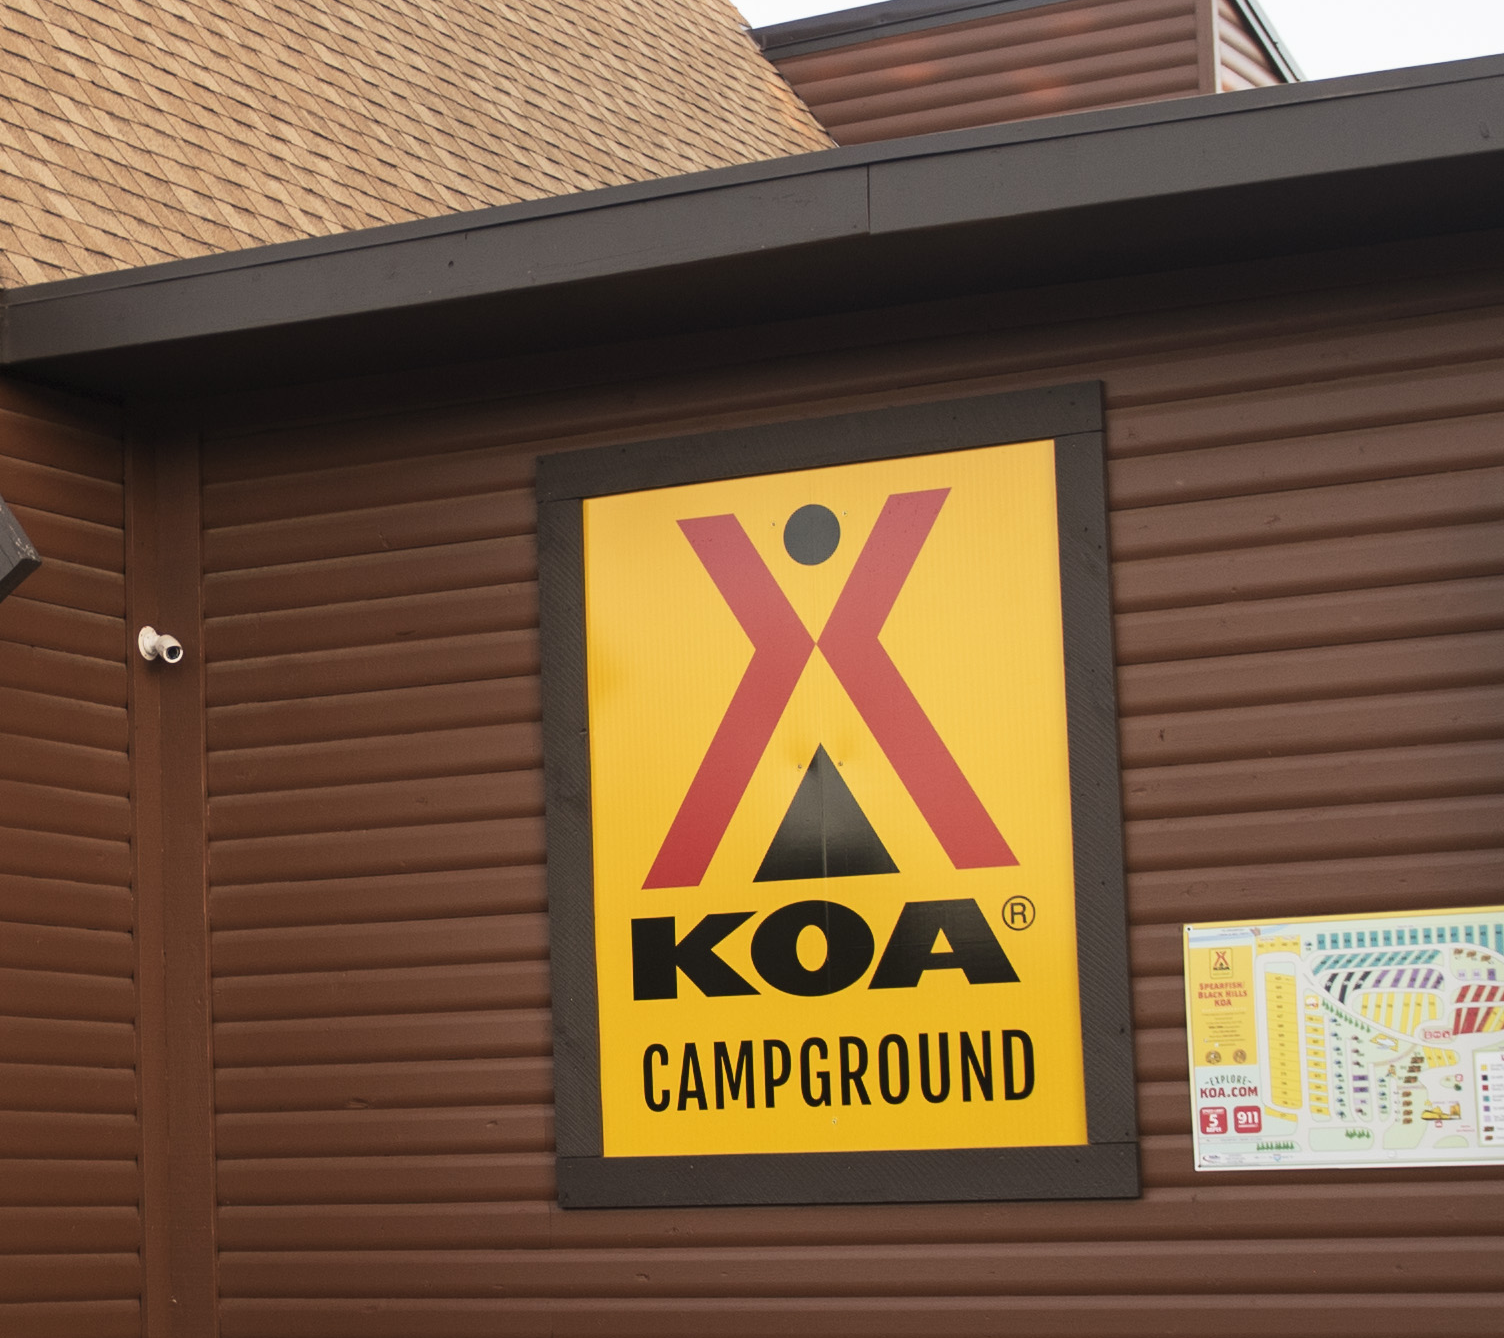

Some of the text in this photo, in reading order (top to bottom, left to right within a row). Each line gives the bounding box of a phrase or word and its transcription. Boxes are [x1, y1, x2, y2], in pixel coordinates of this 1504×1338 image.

[631, 898, 1021, 1001] KOA
[1198, 990, 1248, 999] BLACK HILLS
[1214, 999, 1232, 1007] KOA
[642, 1028, 1037, 1113] CAMPGROUND
[1200, 1086, 1258, 1099] KOA.COM
[1208, 1114, 1218, 1127] 5
[1236, 1111, 1258, 1124] 911
